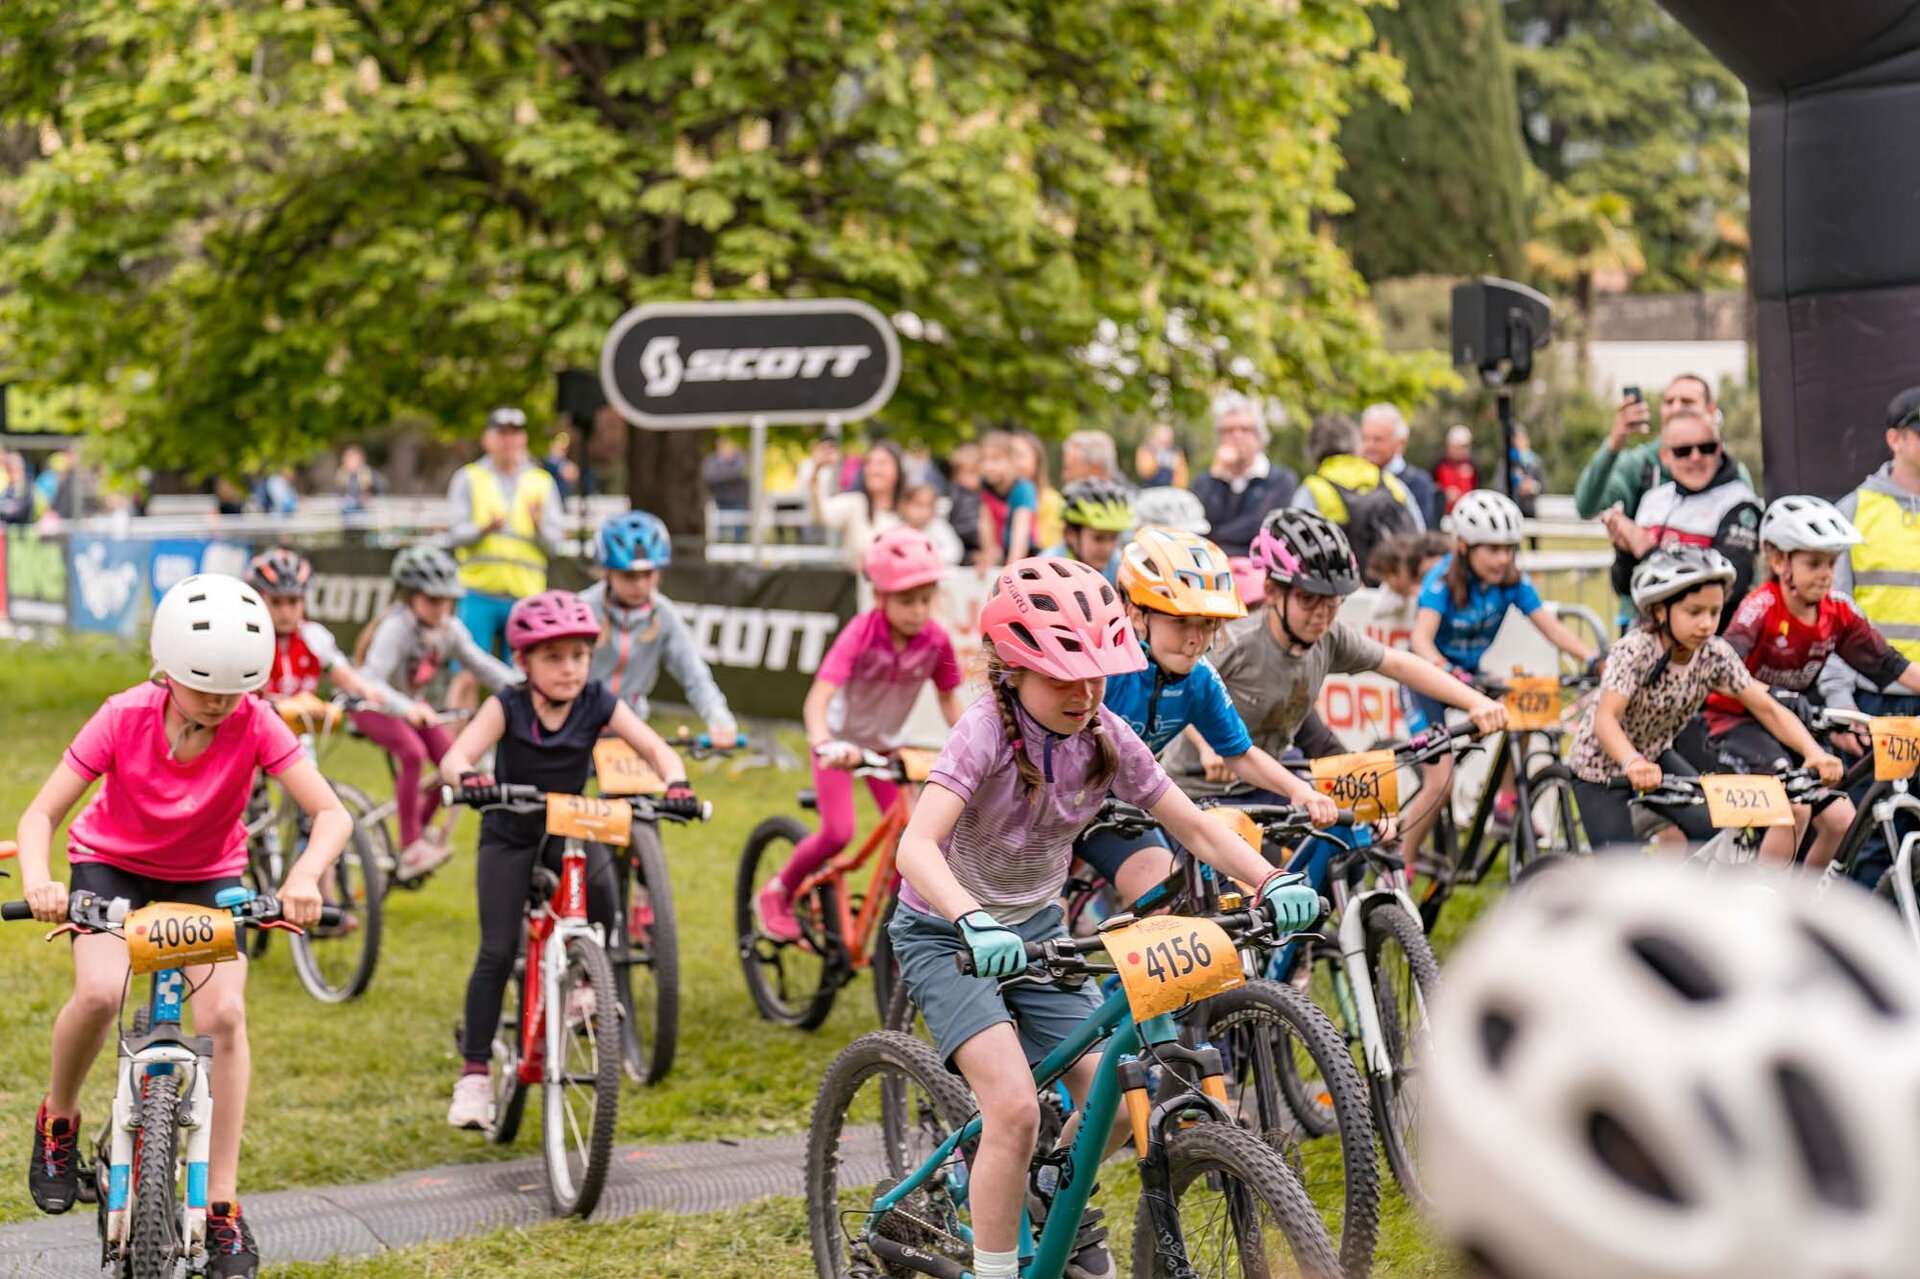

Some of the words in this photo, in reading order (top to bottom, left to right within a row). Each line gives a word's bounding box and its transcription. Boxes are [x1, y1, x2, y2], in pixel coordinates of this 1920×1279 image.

[684, 345, 872, 382] SCOTT
[305, 574, 394, 623] COTT
[1332, 771, 1380, 801] 4061
[1726, 788, 1770, 808] 4321
[149, 915, 214, 949] 4068
[1145, 931, 1212, 983] 4156
